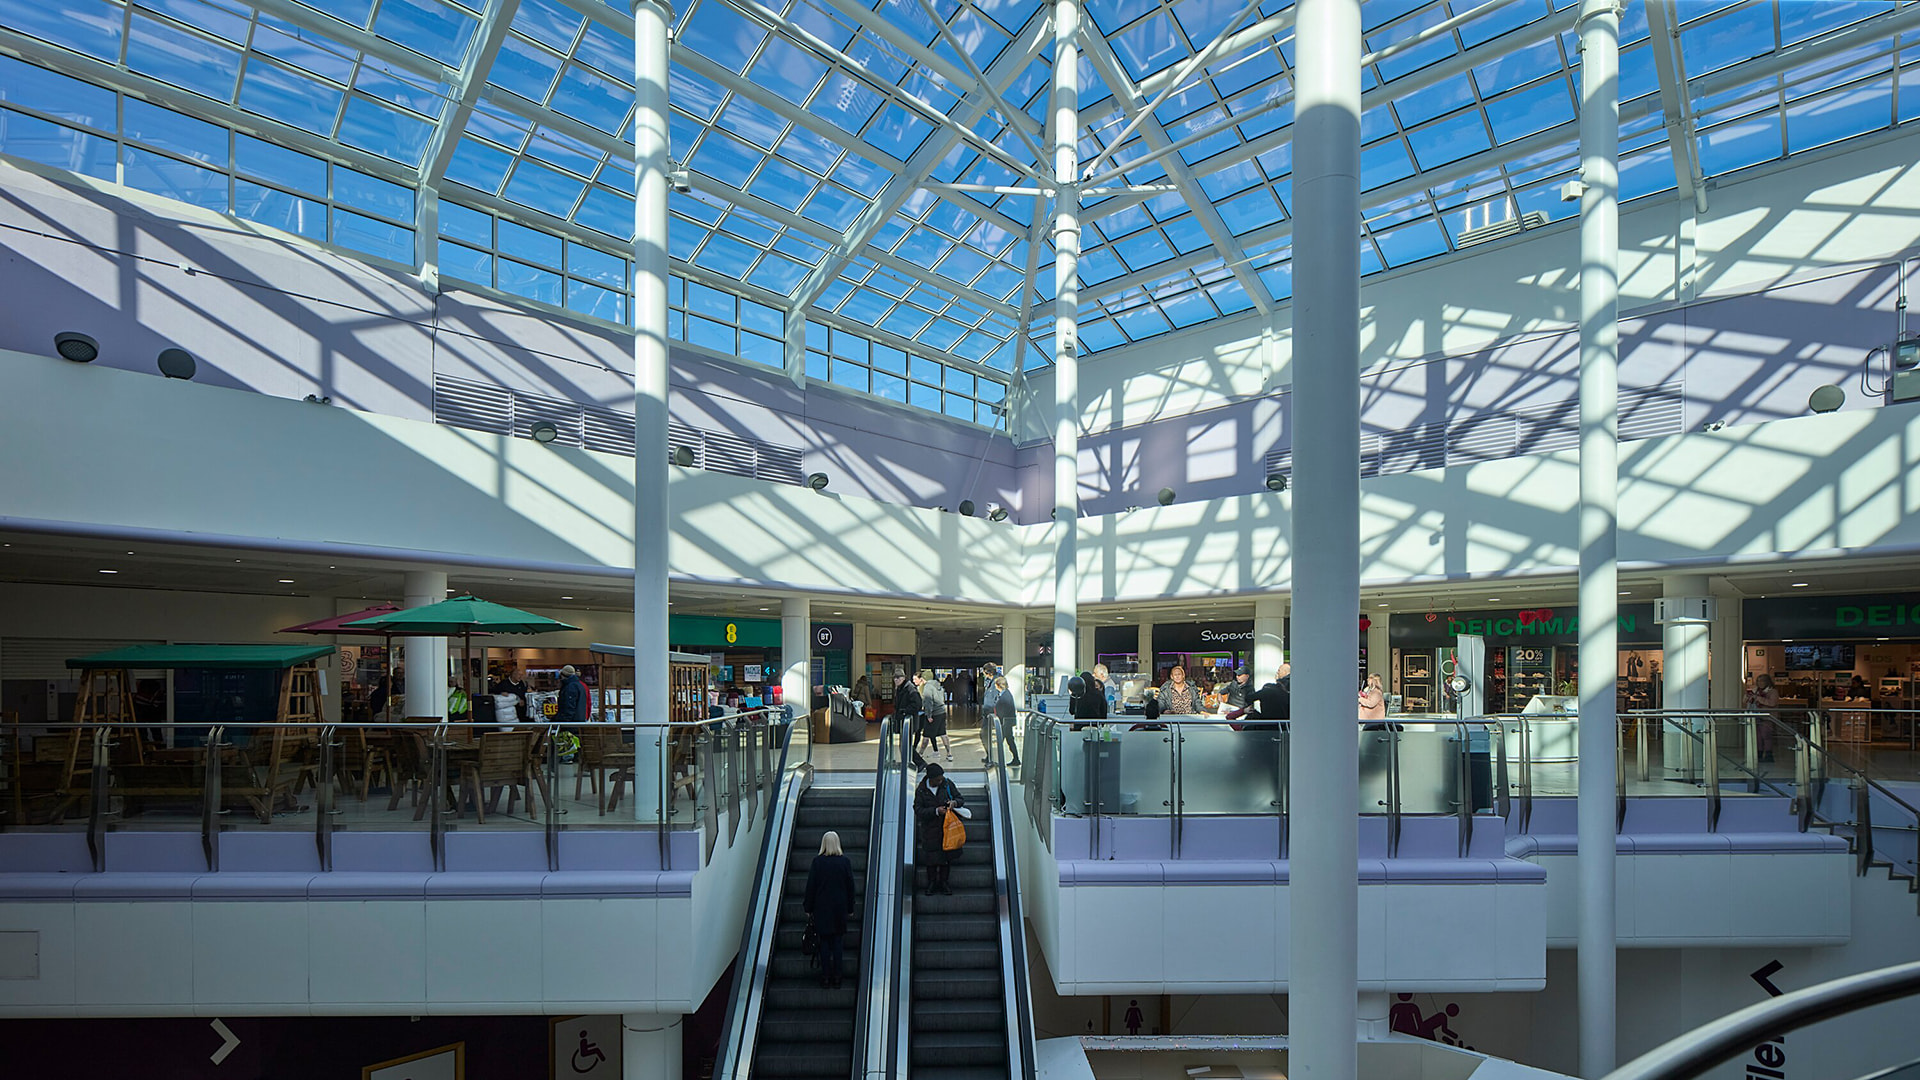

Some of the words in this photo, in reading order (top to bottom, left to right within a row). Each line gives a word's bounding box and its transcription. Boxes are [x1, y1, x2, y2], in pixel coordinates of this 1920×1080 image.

[1448, 614, 1636, 637] DEICHMAN
[1201, 629, 1255, 643] Superd
[1515, 649, 1544, 661] 20%
